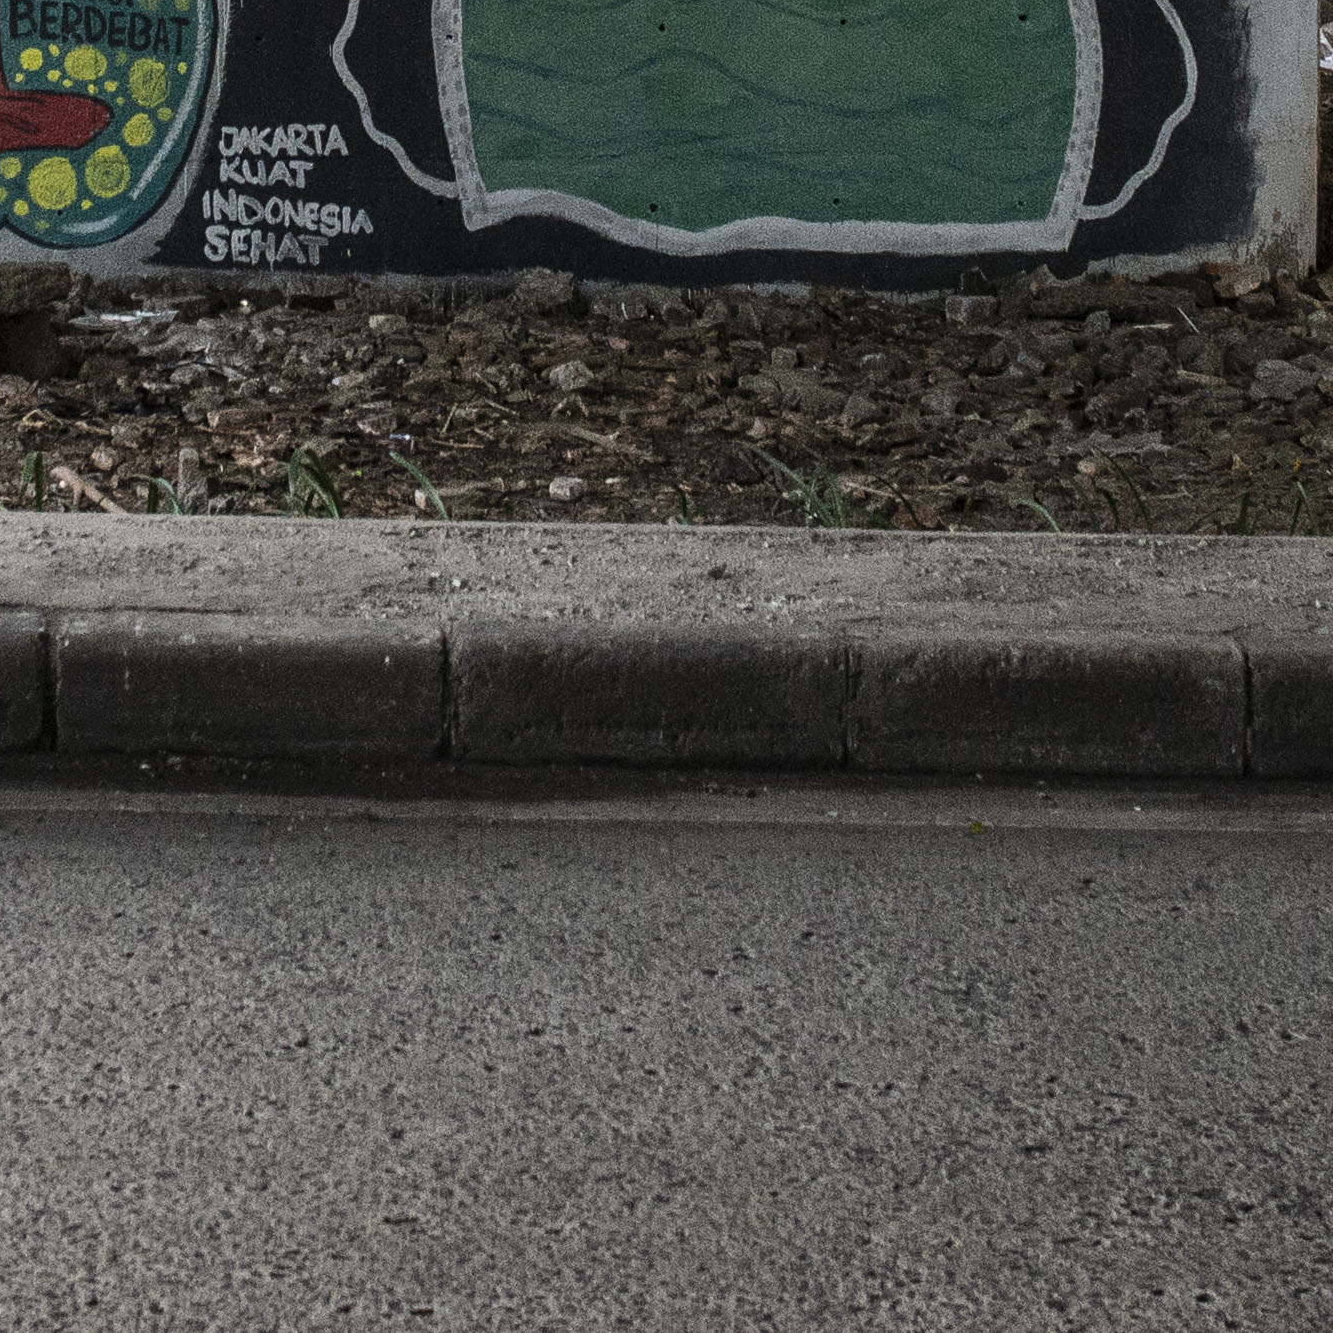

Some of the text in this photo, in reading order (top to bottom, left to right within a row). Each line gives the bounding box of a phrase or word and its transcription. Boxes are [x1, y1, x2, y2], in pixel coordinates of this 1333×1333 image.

[218, 123, 349, 157] JAKARTA
[219, 156, 314, 189] KUAT
[202, 188, 374, 237] INDONESIA
[204, 224, 329, 267] SEHAT
